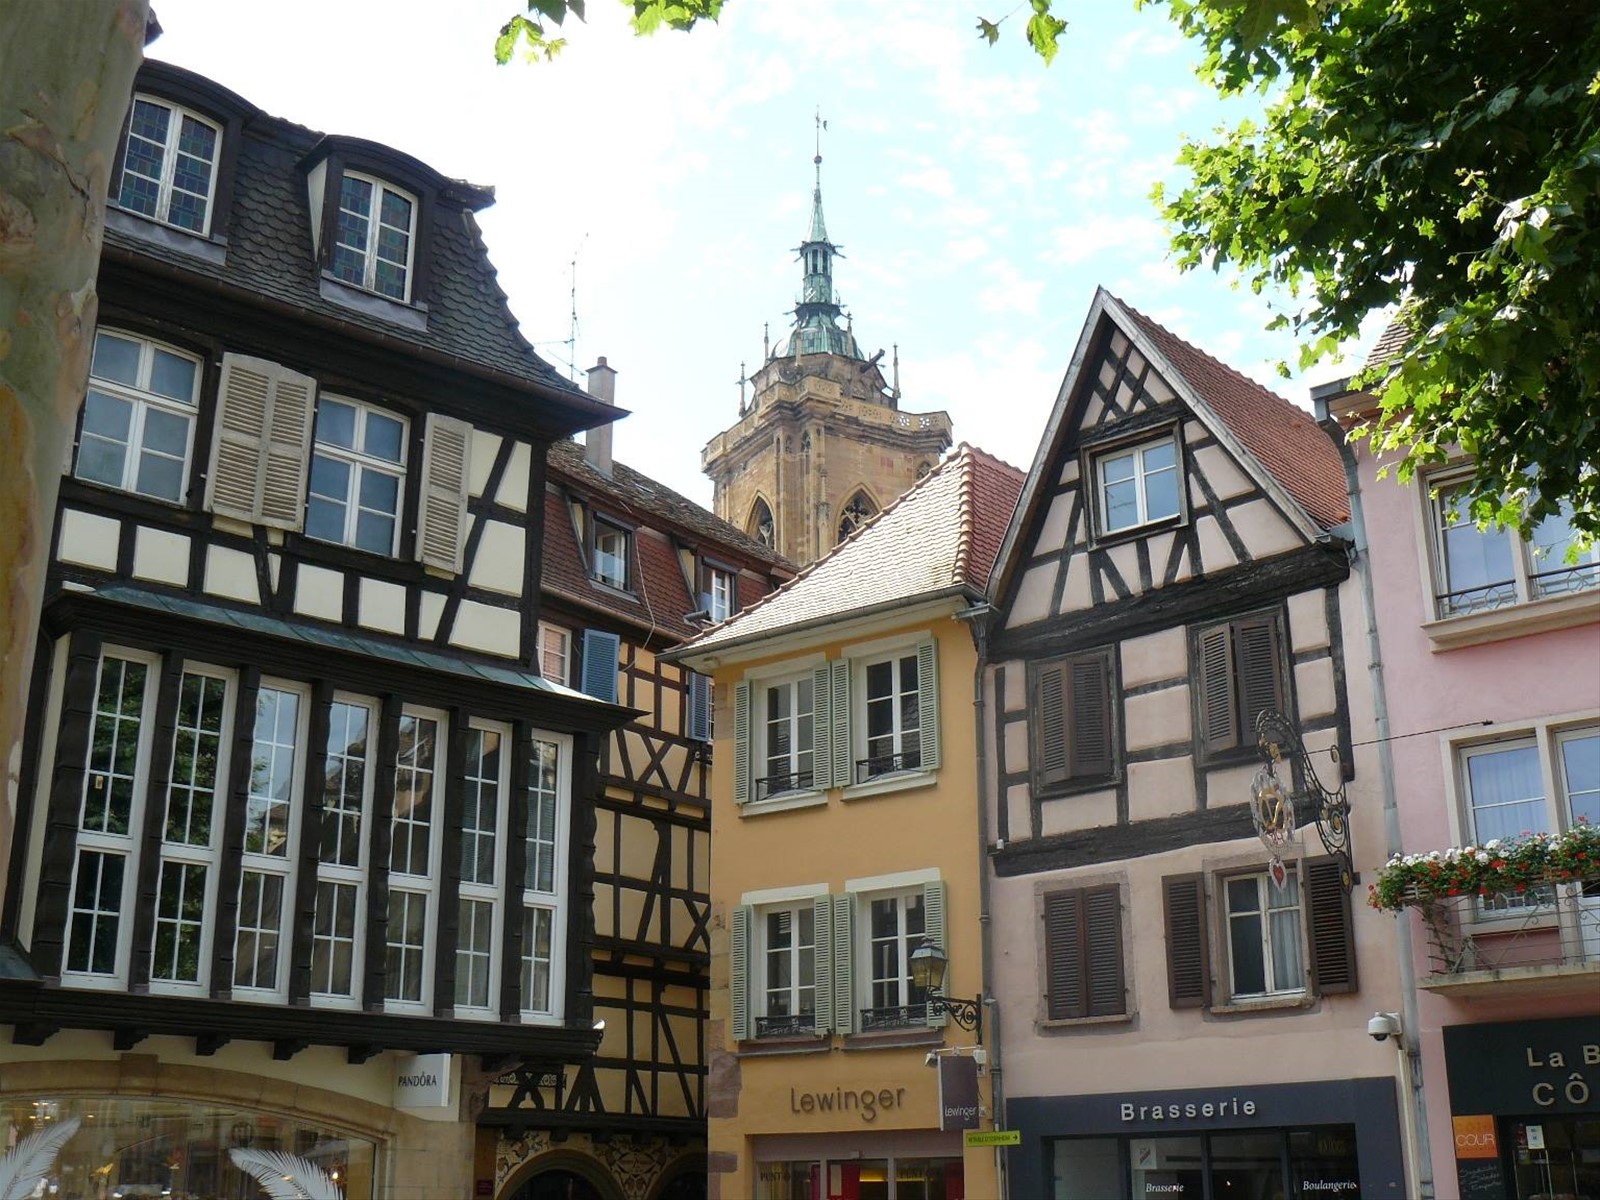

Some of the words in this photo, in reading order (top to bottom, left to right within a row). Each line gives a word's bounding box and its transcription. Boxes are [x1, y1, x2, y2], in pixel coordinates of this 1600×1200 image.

[1527, 1047, 1566, 1068] La
[1532, 1072, 1589, 1106] CÔ
[790, 1086, 906, 1122] Lewinger
[1120, 1097, 1256, 1121] Brasserie
[1455, 1133, 1496, 1147] COUR
[1145, 1181, 1185, 1193] Brasserie
[1302, 1179, 1356, 1193] Boulangerie
